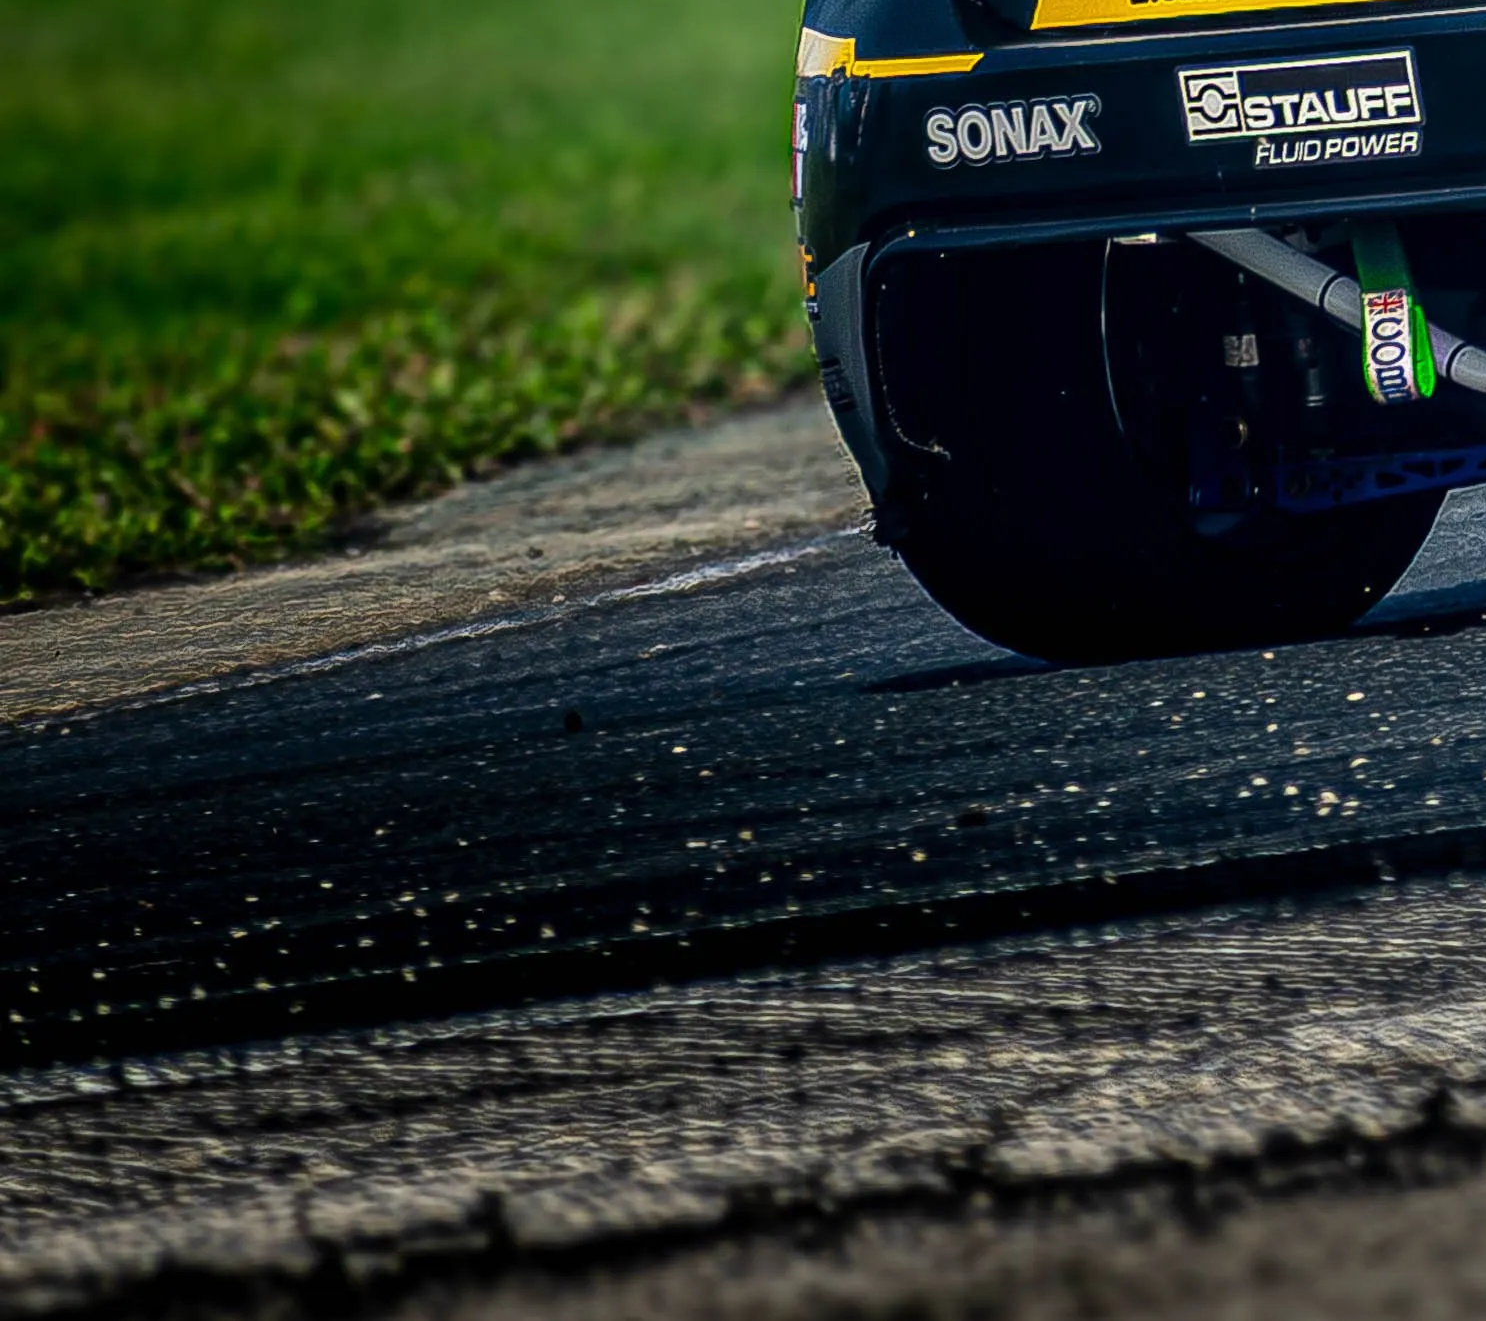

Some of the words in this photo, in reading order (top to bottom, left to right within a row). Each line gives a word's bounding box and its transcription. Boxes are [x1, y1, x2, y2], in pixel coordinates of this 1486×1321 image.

[1242, 83, 1412, 129] STAUFF
[927, 99, 1097, 164] SONAX
[1255, 139, 1321, 166] FLUID
[1323, 131, 1419, 159] POWER
